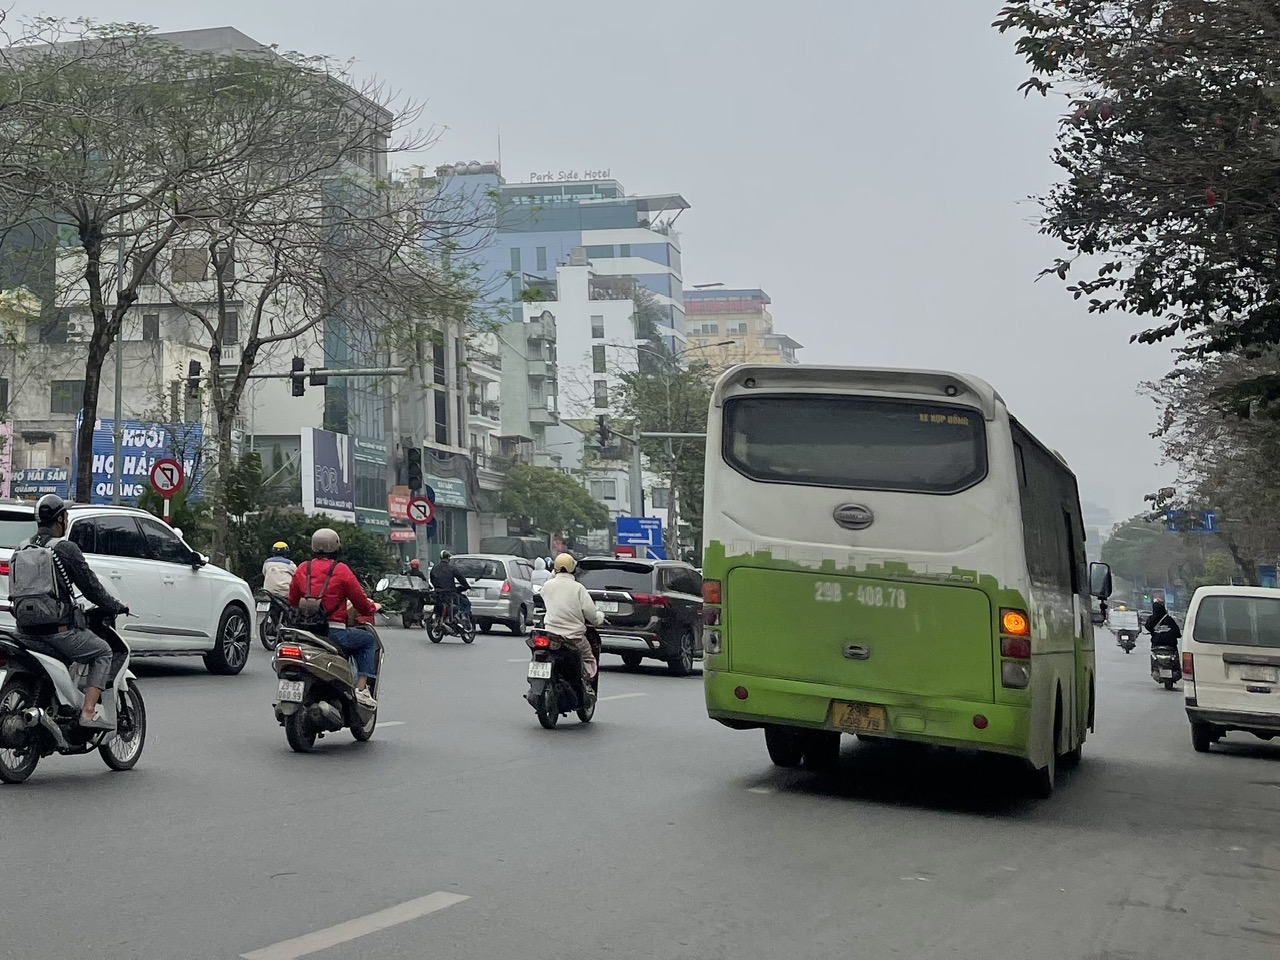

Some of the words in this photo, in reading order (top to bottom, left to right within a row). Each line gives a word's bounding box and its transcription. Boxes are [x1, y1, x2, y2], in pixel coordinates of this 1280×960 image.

[530, 171, 553, 181] Park
[558, 170, 579, 180] Side
[584, 168, 611, 179] Hotel
[27, 468, 45, 481] HẢI
[46, 467, 68, 481] SẢN
[314, 464, 339, 495] FOR
[14, 484, 38, 493] QUẢNG
